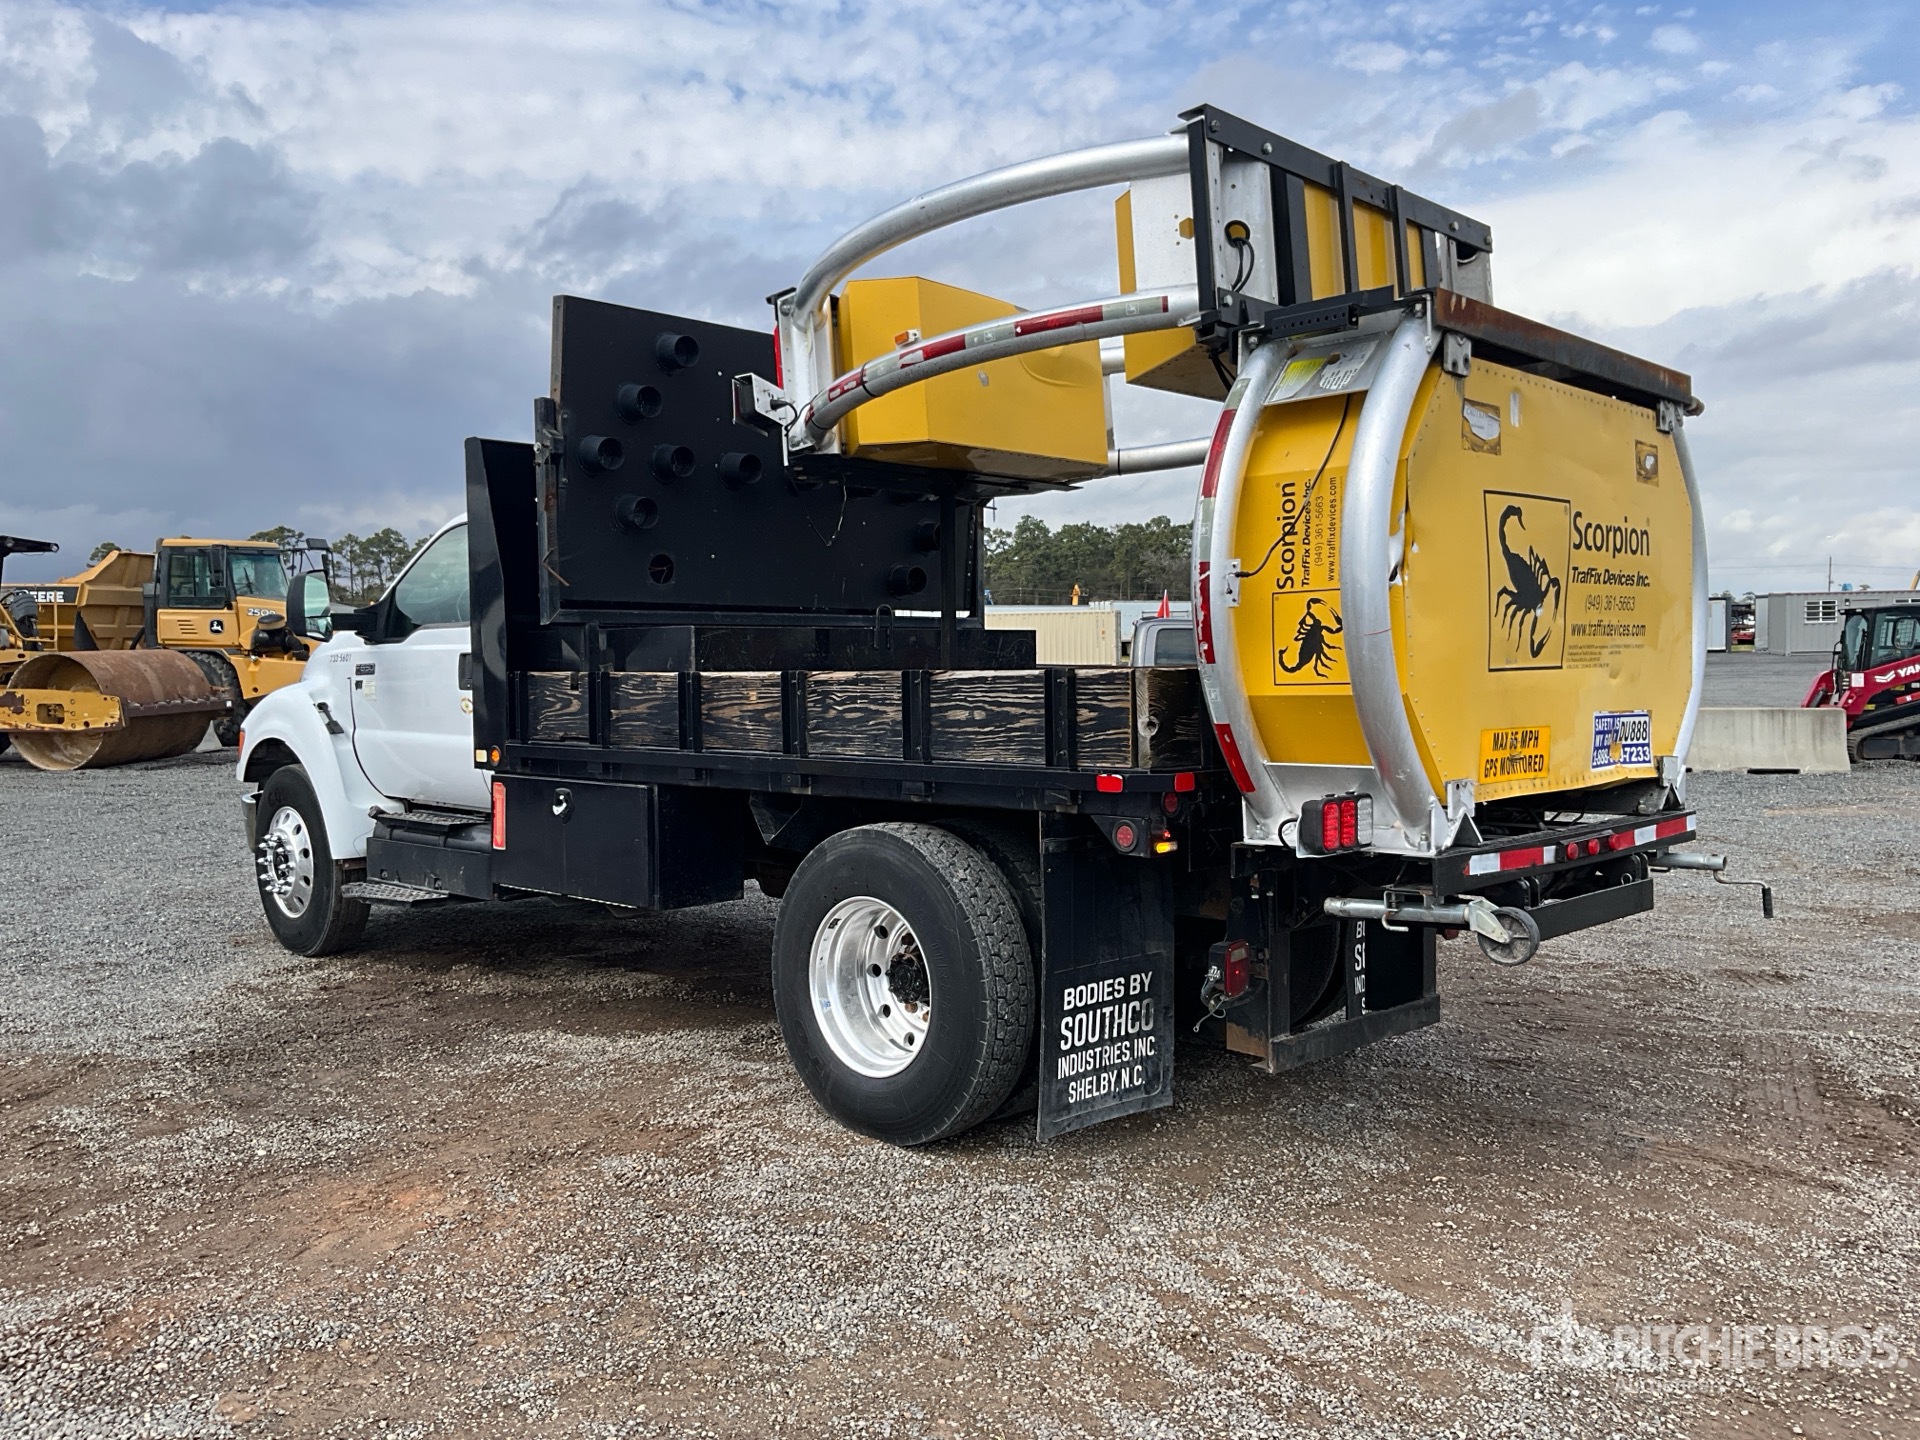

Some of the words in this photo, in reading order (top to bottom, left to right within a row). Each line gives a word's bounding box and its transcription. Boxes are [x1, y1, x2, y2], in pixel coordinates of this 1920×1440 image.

[1276, 482, 1298, 590] Scorpion
[1302, 500, 1311, 545] Devices
[1314, 495, 1324, 540] 361-5663
[1327, 476, 1337, 582] www.traffixdevices.com
[1572, 511, 1650, 558] Scorpion
[1314, 543, 1324, 567] (949)
[1602, 569, 1635, 587] Devices
[1635, 571, 1650, 587] Inc.
[1584, 594, 1603, 614] (949)
[1603, 594, 1636, 612] 361-5663
[1571, 619, 1646, 637] www.traffixdevices.com
[1492, 732, 1509, 751] MAX
[1520, 729, 1539, 749] MPH
[1484, 758, 1498, 778] GPS
[1063, 976, 1125, 1011] BODIES
[1129, 971, 1153, 996] BY
[1060, 997, 1154, 1051] SOUTHCO
[1068, 1070, 1119, 1104] SHELBY,
[1121, 1065, 1146, 1091] N.C.
